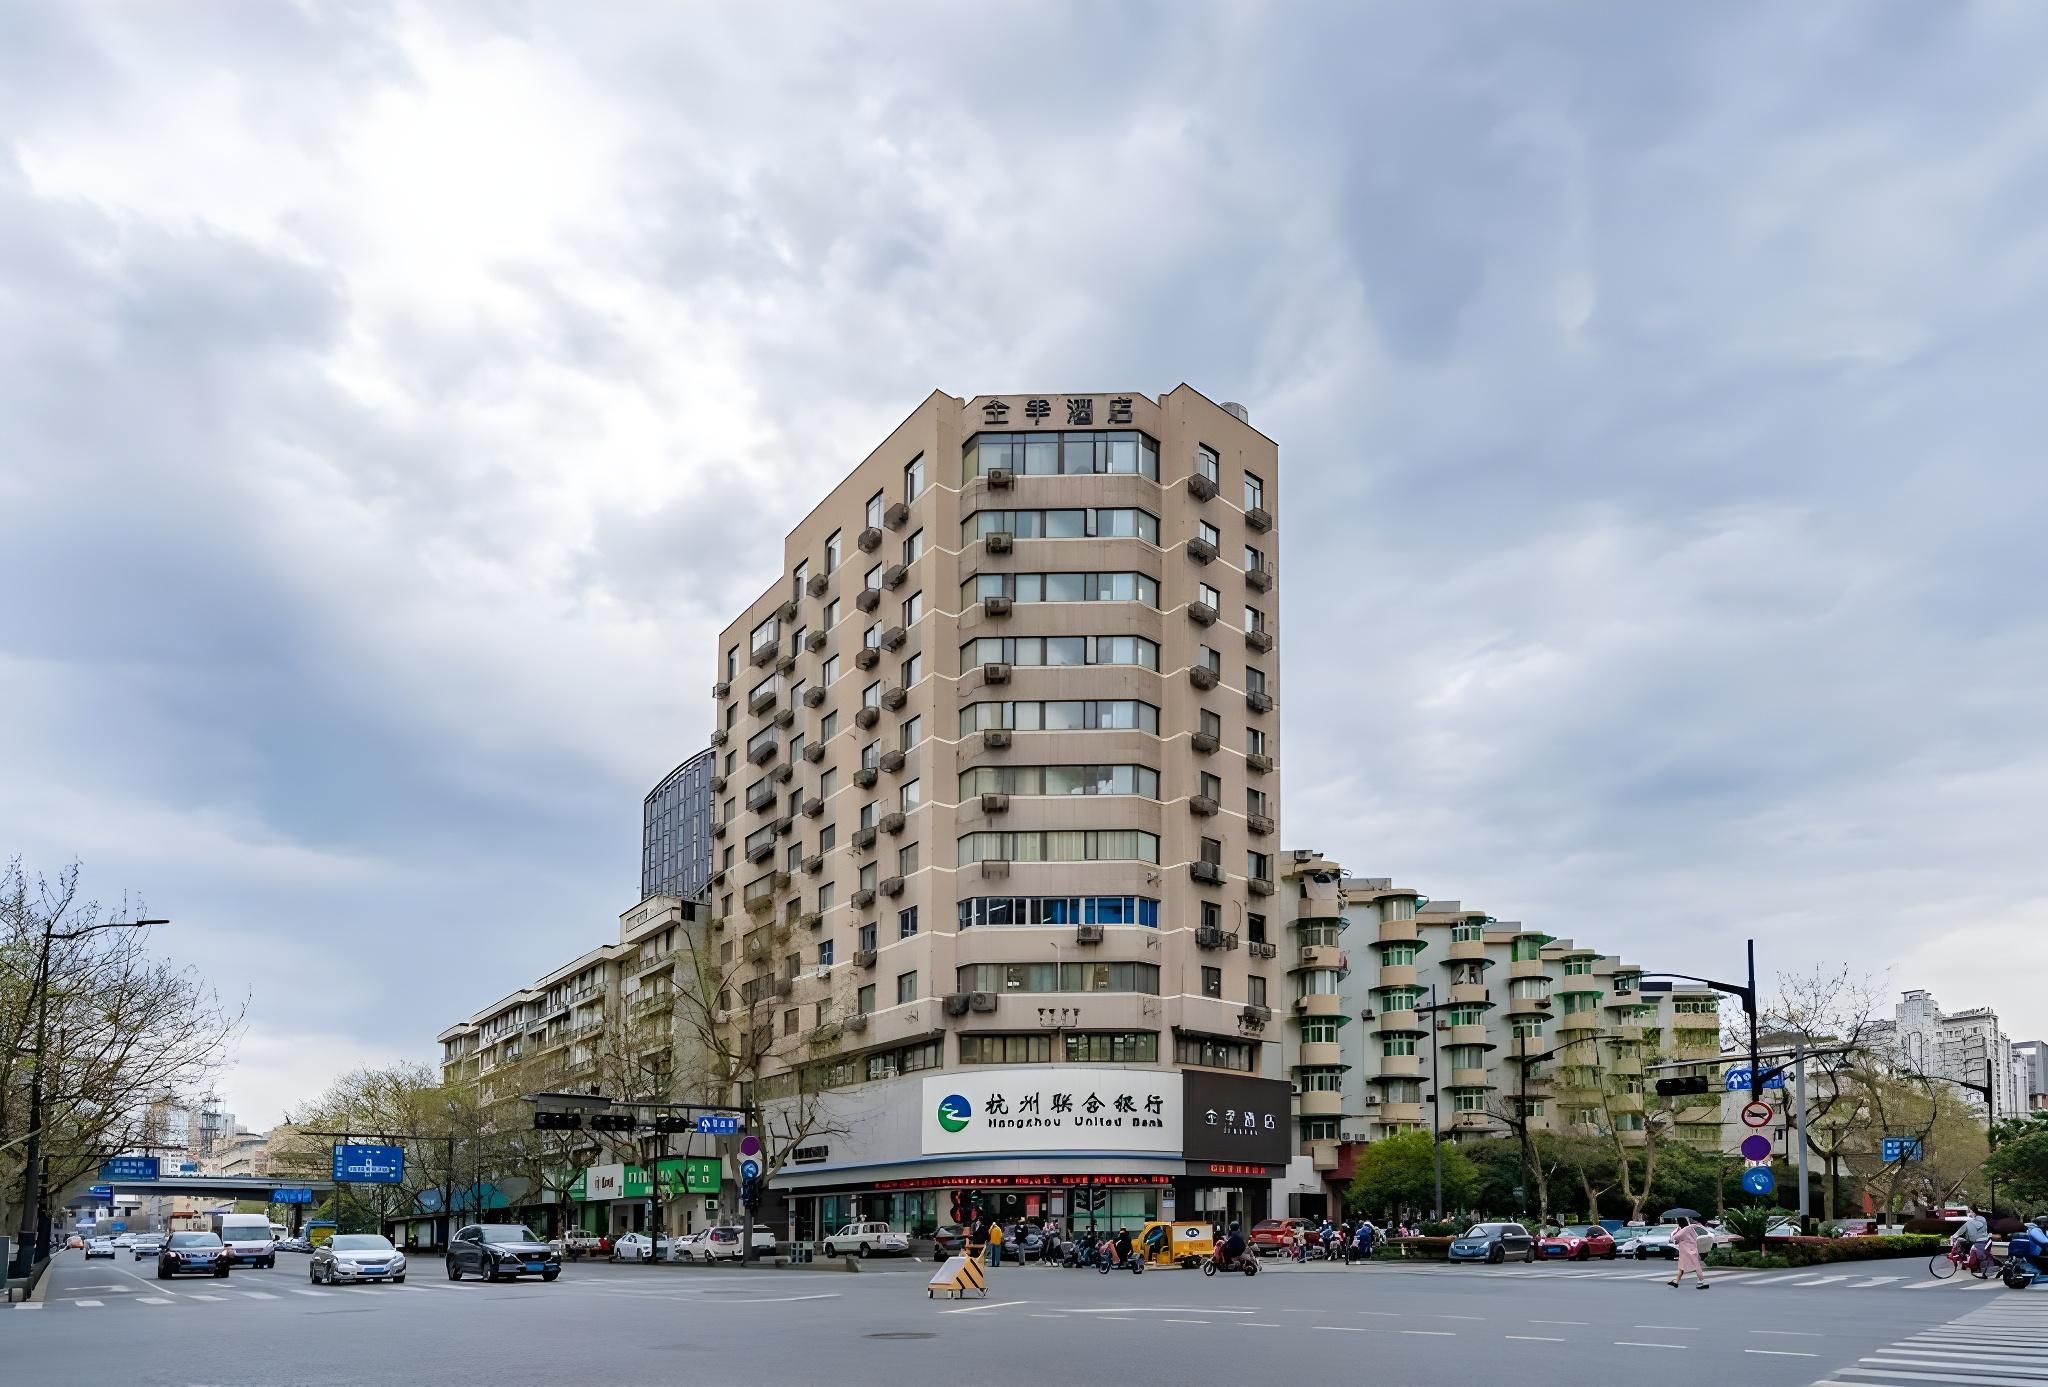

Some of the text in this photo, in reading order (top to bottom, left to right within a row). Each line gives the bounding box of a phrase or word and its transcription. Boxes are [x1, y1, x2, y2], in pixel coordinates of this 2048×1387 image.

[982, 397, 1133, 425] 全季酒店
[985, 1092, 1163, 1115] 杭州联合银行
[1132, 1117, 1164, 1128] Bank
